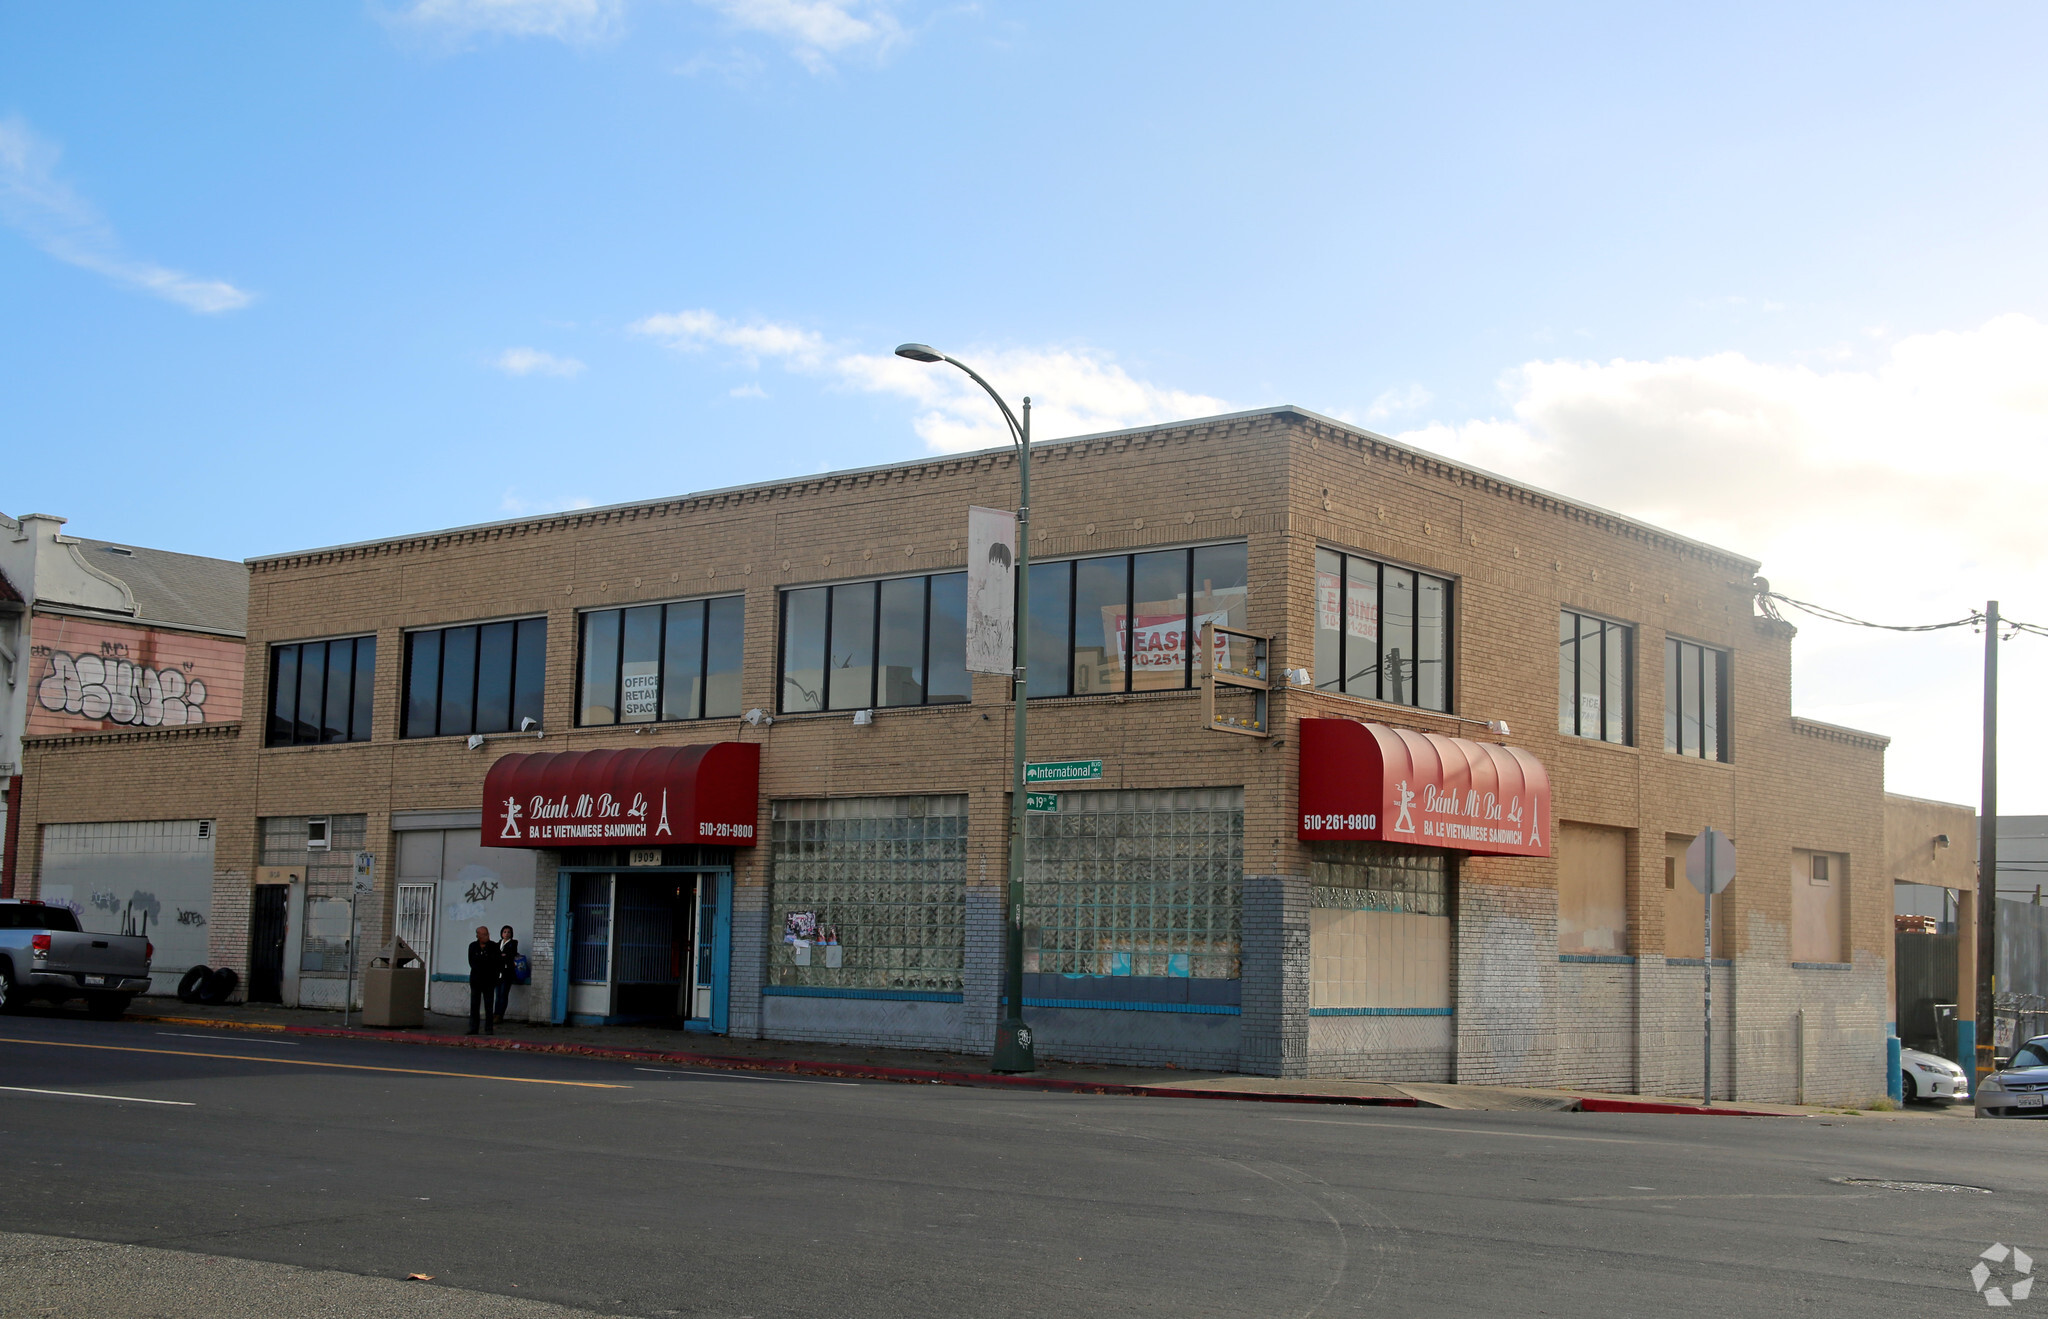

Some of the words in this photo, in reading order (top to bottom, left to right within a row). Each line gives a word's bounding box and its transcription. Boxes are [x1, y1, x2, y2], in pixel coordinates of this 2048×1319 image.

[1037, 764, 1091, 779] International
[529, 794, 569, 820] Bánh
[570, 793, 594, 818] Mì
[597, 792, 621, 818] Ba
[1423, 783, 1459, 816] Bánh
[1461, 788, 1481, 818] Mì
[1483, 791, 1503, 820] Ba
[699, 822, 753, 838] 510-261-9800
[1304, 814, 1376, 830] 510-261-9800
[529, 825, 540, 838] BA
[542, 825, 552, 838] LE
[553, 824, 603, 838] VIETNAMESE
[604, 823, 647, 838] SANDWICH
[1423, 820, 1434, 836] BA
[1435, 821, 1445, 837] LE
[1445, 822, 1488, 842] VIETNAMESE
[1488, 828, 1523, 845] SANDWICH
[634, 852, 655, 863] 1909
